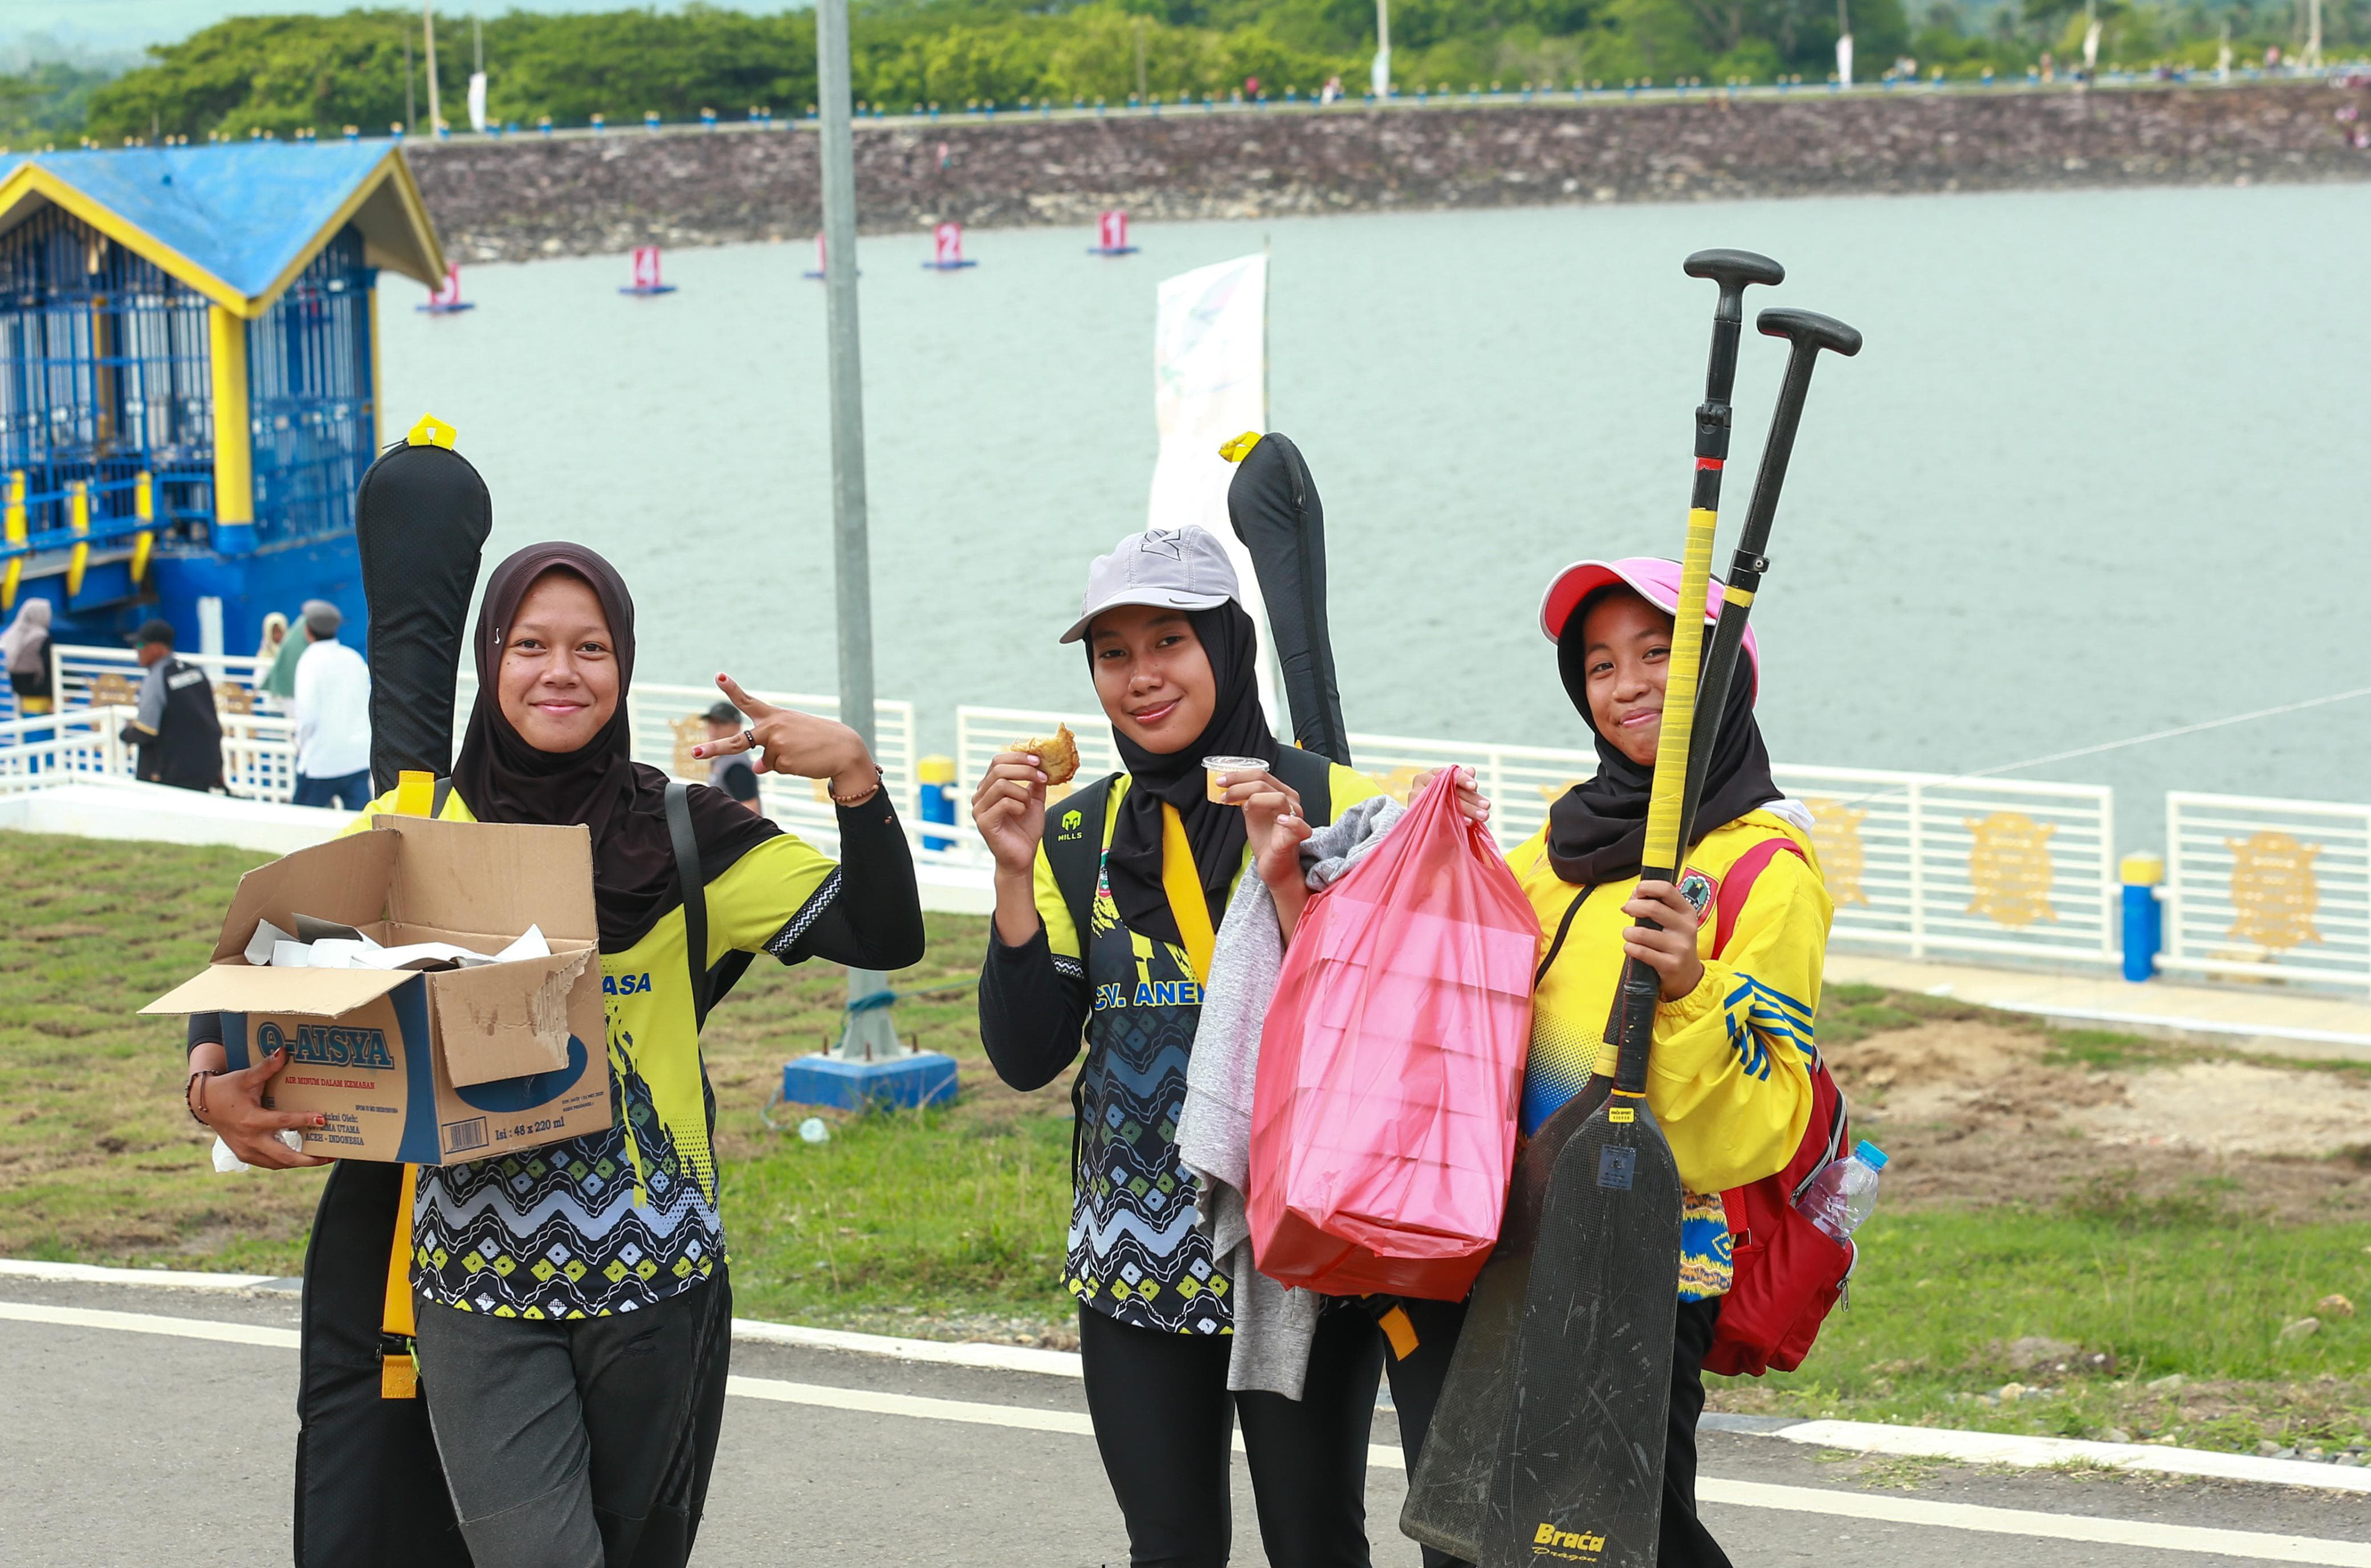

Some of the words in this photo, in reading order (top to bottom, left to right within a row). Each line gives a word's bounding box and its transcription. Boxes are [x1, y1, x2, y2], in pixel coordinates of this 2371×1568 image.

[1107, 213, 1121, 249] 1
[939, 225, 958, 262] 2
[637, 248, 657, 286] 4
[1058, 832, 1082, 841] MILLS
[298, 1077, 319, 1086] MINUM
[321, 1078, 343, 1088] DALAM
[344, 1080, 375, 1089] KEMASAN
[337, 1125, 360, 1134] UTAMA
[495, 1129, 507, 1140] Isi
[514, 1125, 525, 1136] 48
[527, 1125, 533, 1134] x
[535, 1119, 551, 1133] 220
[553, 1116, 565, 1128] ml
[305, 1133, 324, 1142] ACEH
[329, 1135, 365, 1146] INDONESIA
[1533, 1522, 1606, 1553] Braća
[1532, 1546, 1598, 1562] Dragon
